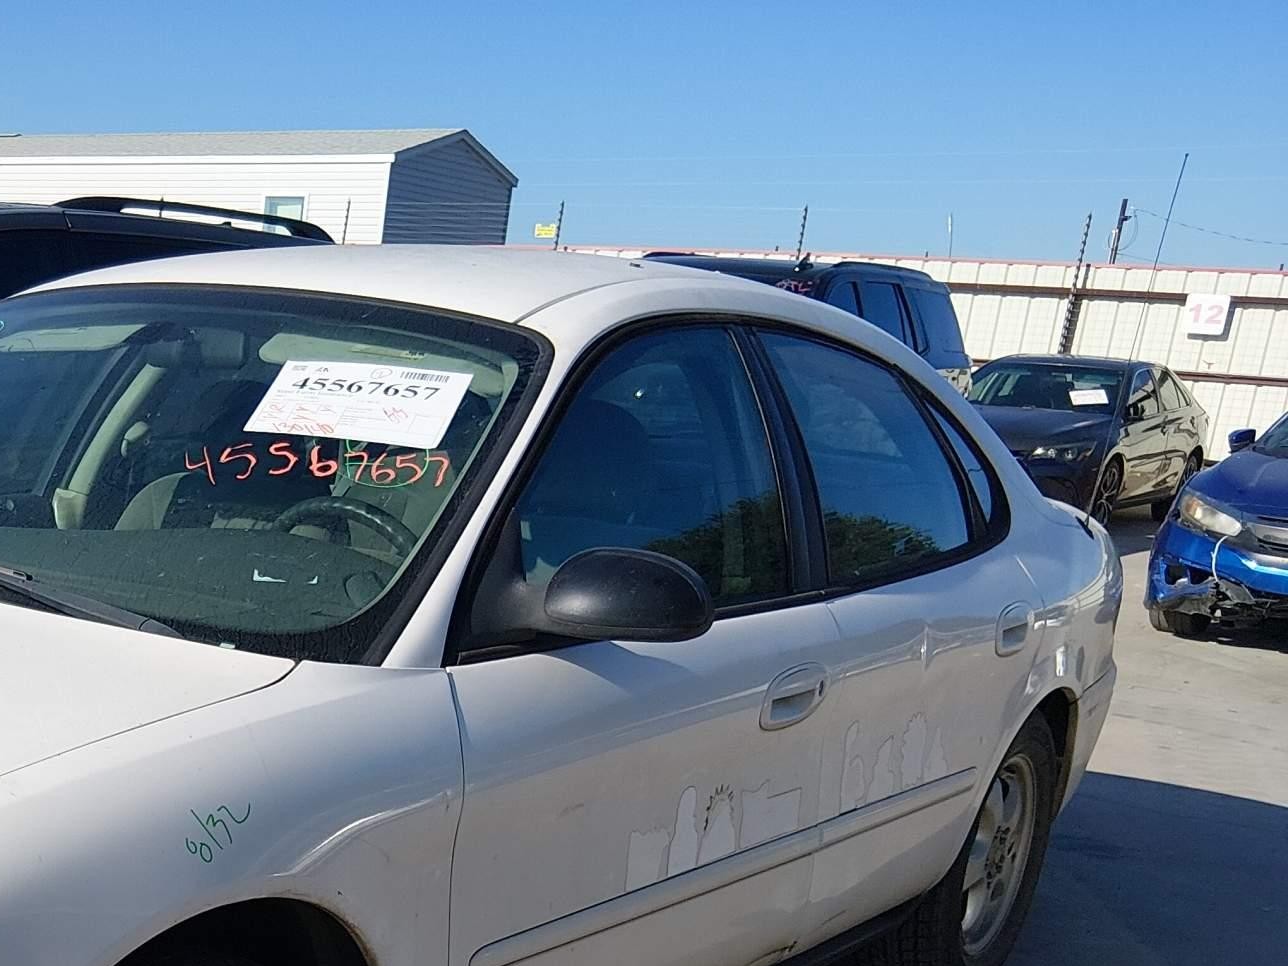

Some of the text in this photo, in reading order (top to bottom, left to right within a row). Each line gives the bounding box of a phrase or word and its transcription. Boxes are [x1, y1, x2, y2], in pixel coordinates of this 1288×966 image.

[1189, 303, 1224, 324] 12
[291, 377, 441, 400] 45567657
[185, 443, 449, 487] 45567657
